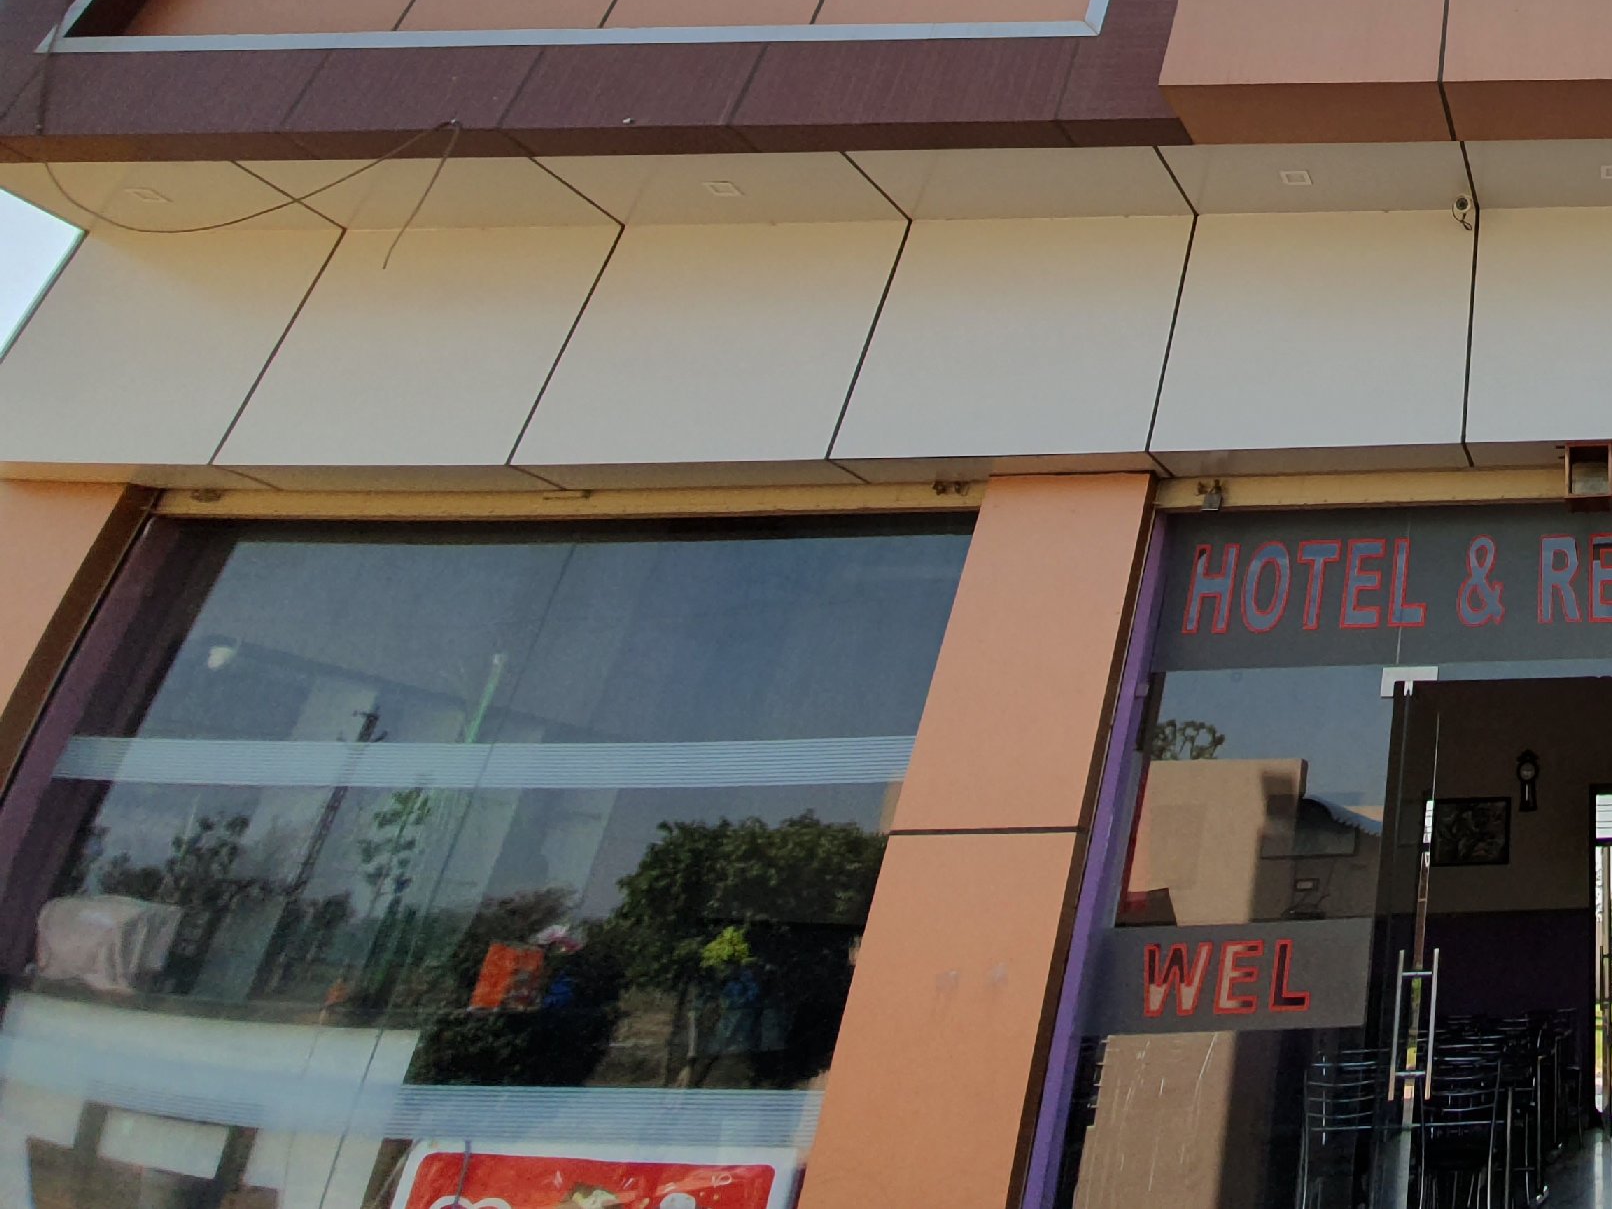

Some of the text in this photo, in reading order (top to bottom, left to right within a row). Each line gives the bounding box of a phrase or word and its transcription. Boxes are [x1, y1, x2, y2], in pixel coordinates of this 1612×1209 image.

[1181, 537, 1427, 634] HOTEL
[1457, 534, 1505, 627] &
[1143, 938, 1312, 1018] WEL
